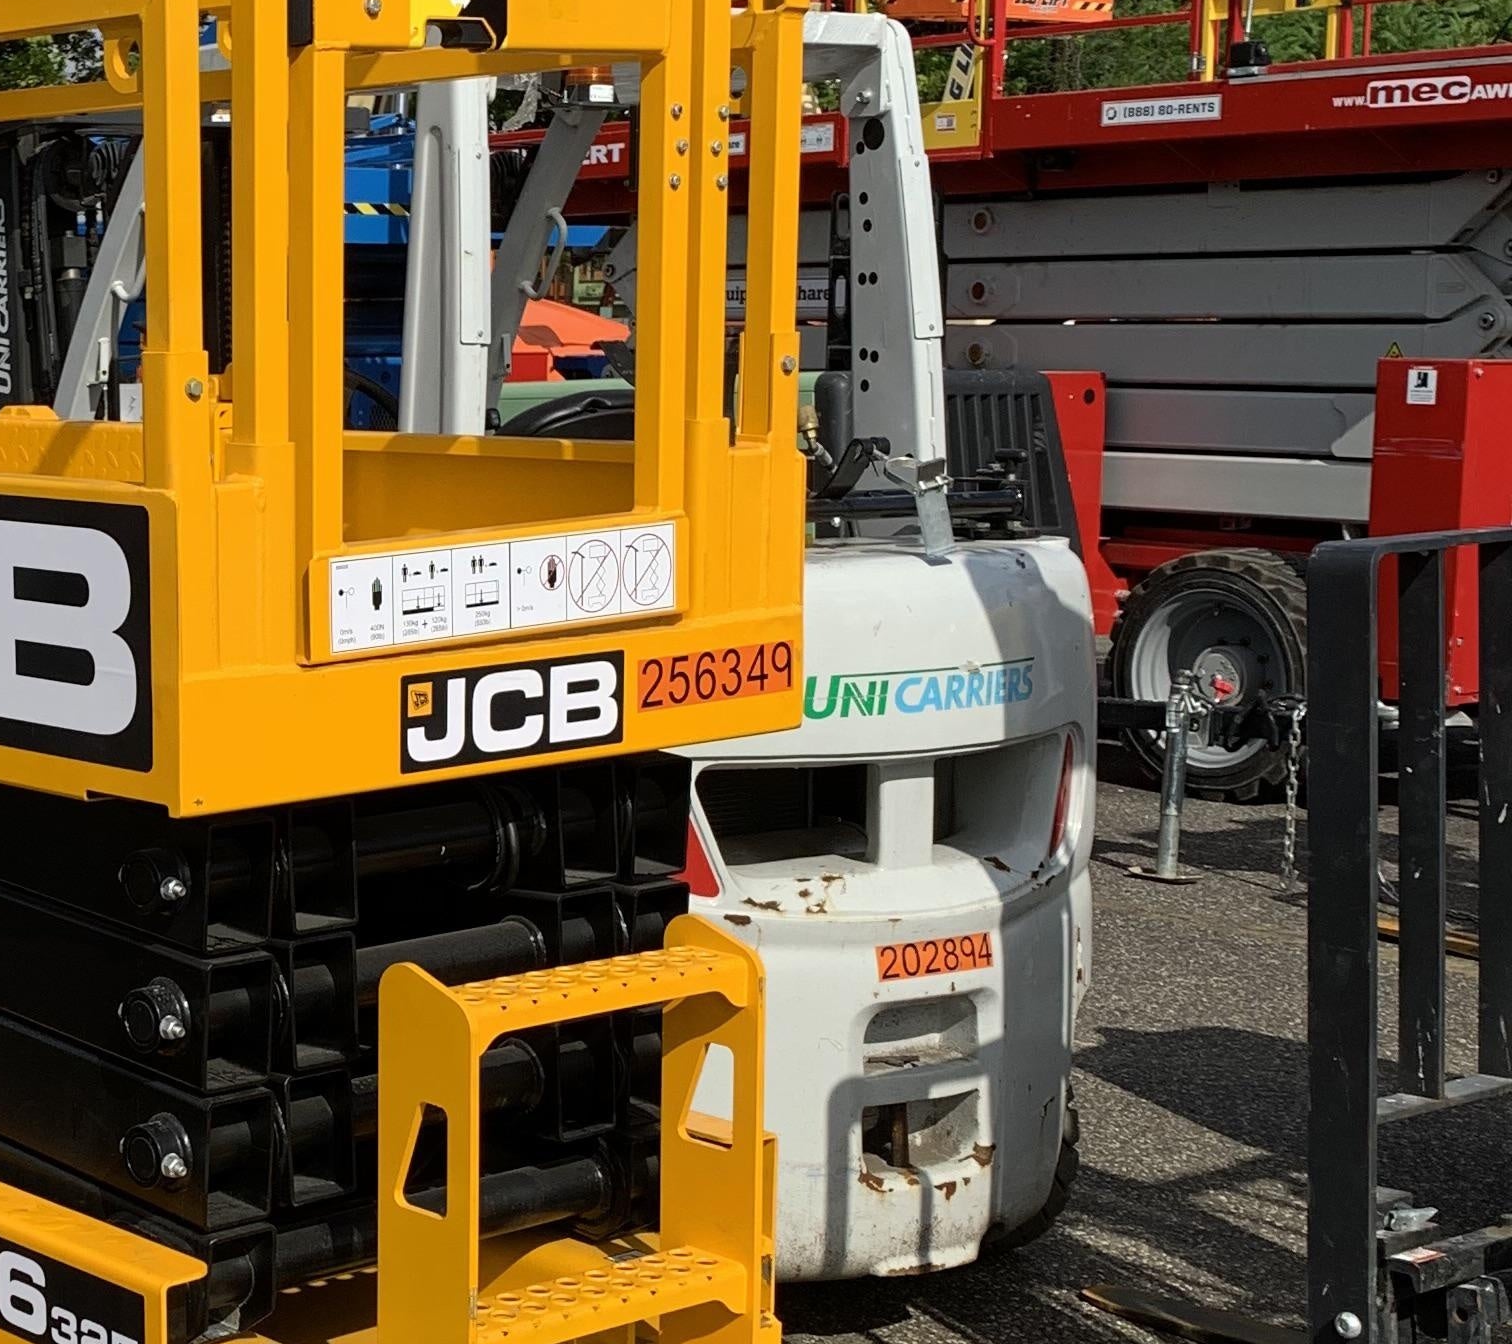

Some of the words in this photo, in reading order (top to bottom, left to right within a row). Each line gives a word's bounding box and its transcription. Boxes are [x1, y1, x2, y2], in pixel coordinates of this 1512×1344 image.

[1157, 102, 1216, 116] 80-RENTS
[640, 640, 793, 709] 256349
[406, 660, 619, 763] JCB
[880, 932, 993, 980] 202894
